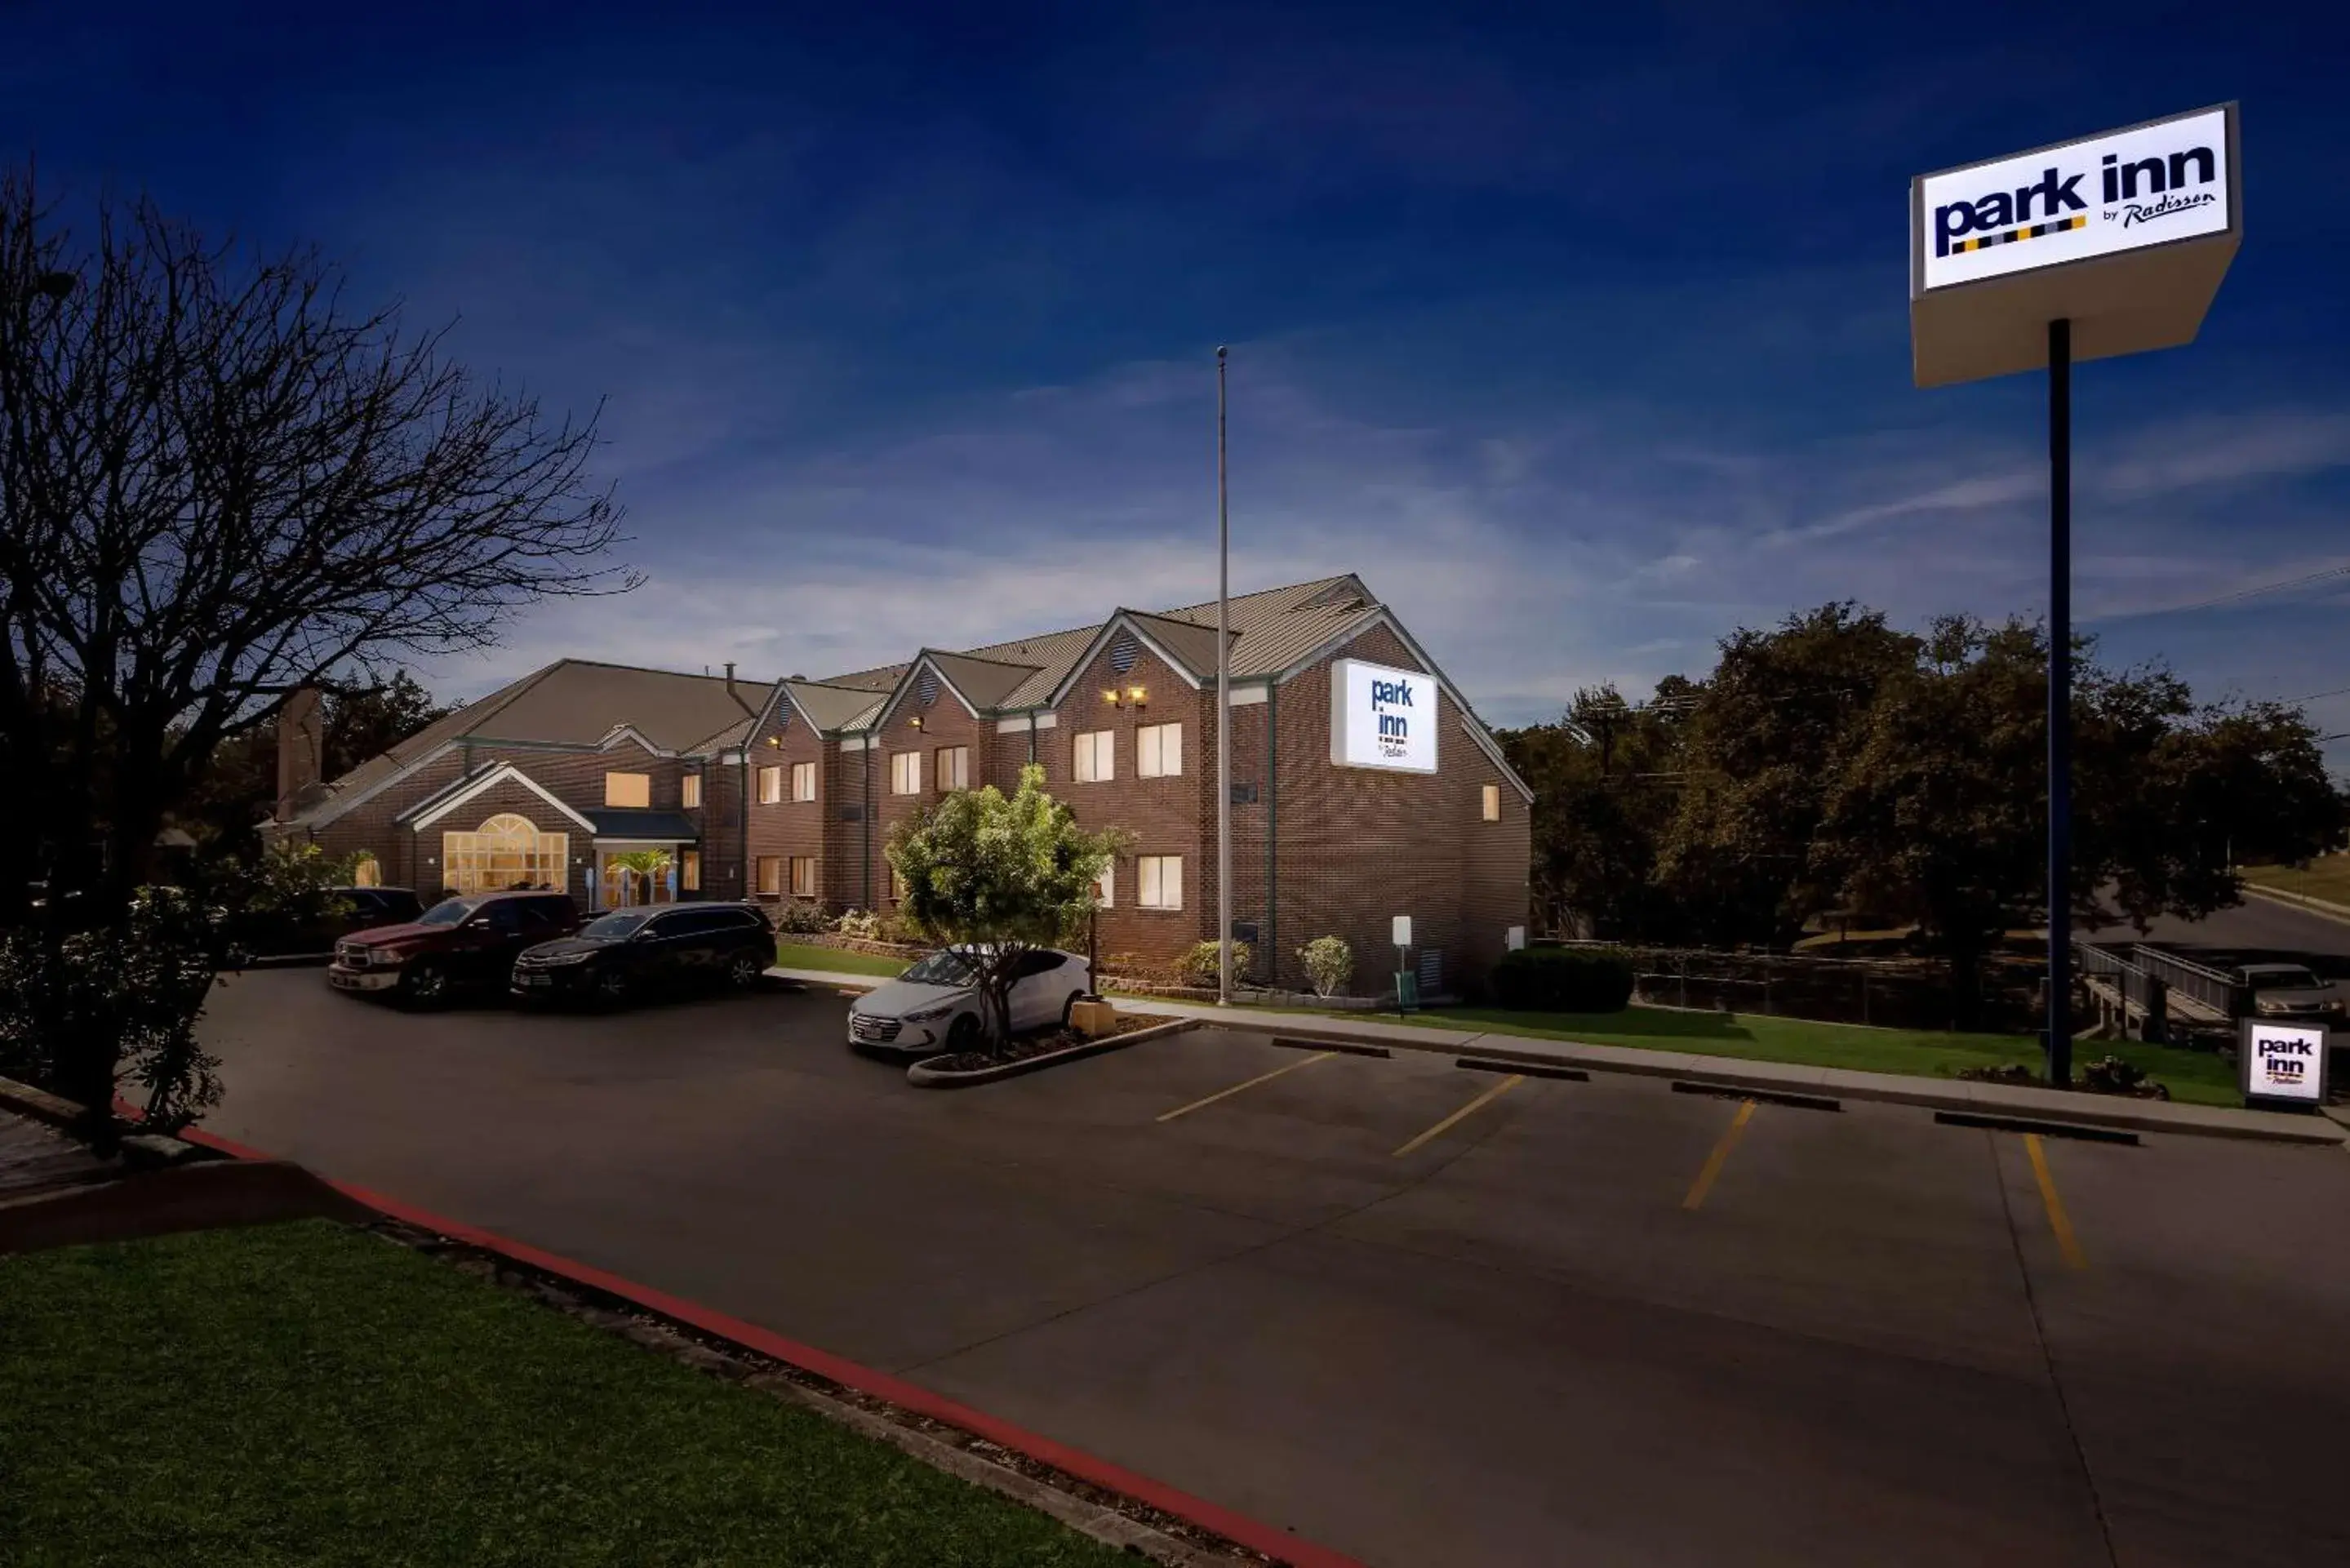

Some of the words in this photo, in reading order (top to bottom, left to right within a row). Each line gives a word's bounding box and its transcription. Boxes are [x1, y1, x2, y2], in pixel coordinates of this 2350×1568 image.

[1935, 167, 2088, 258] park
[2102, 146, 2215, 204] inn
[2103, 210, 2118, 221] by
[2123, 192, 2216, 229] Radisson
[1371, 679, 1414, 712] park
[1379, 706, 1407, 738] inn
[2259, 1037, 2313, 1057] park
[2267, 1054, 2304, 1073] inn
